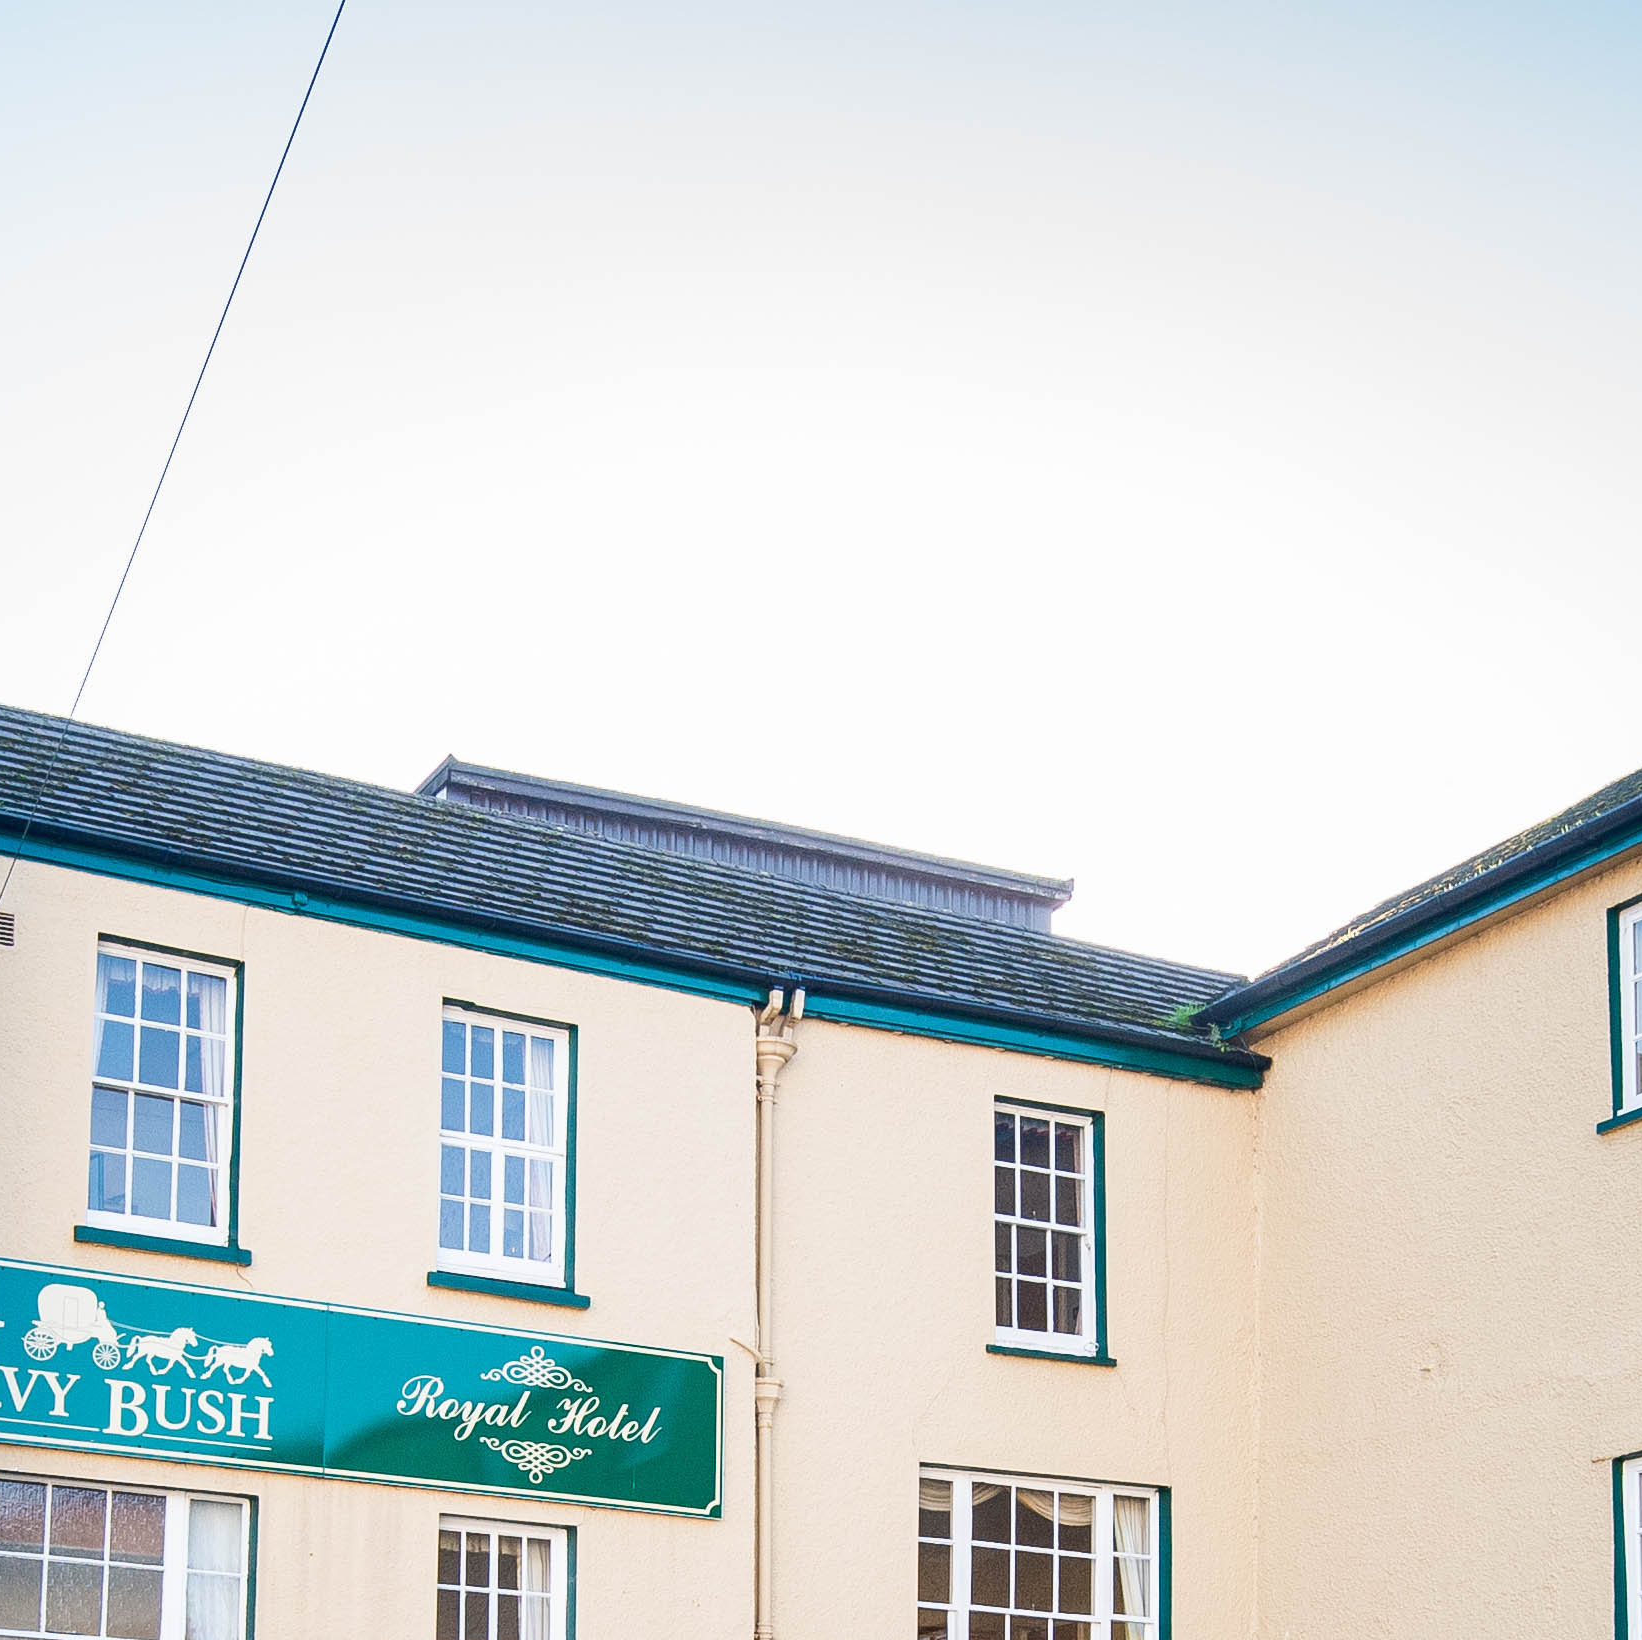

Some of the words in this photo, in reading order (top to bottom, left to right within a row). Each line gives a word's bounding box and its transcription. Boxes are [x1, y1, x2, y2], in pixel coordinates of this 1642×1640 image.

[101, 1377, 275, 1441] BUSH
[396, 1374, 533, 1442] Royal
[547, 1396, 663, 1444] Hotel
